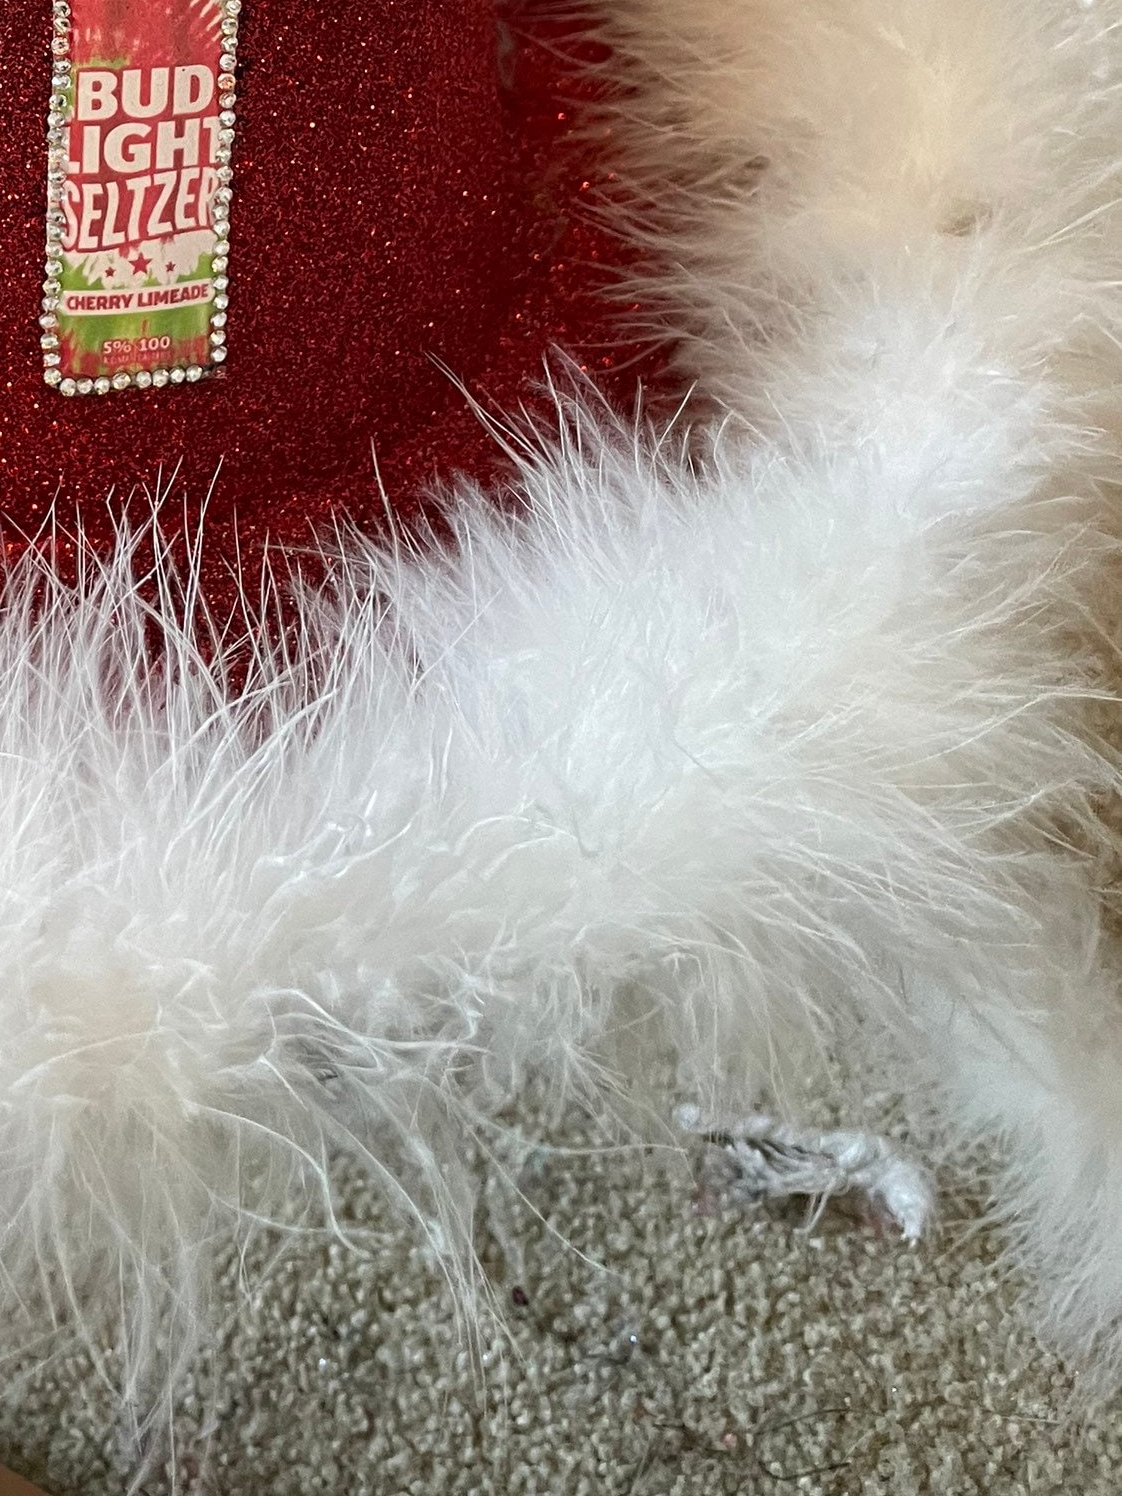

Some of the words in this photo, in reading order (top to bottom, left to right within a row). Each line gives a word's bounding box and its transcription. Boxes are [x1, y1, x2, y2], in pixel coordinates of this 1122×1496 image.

[77, 64, 215, 121] BUD
[66, 293, 135, 311] CHERRY
[137, 284, 210, 308] LIMEADE
[103, 341, 132, 354] 5%
[139, 335, 171, 352] 100
